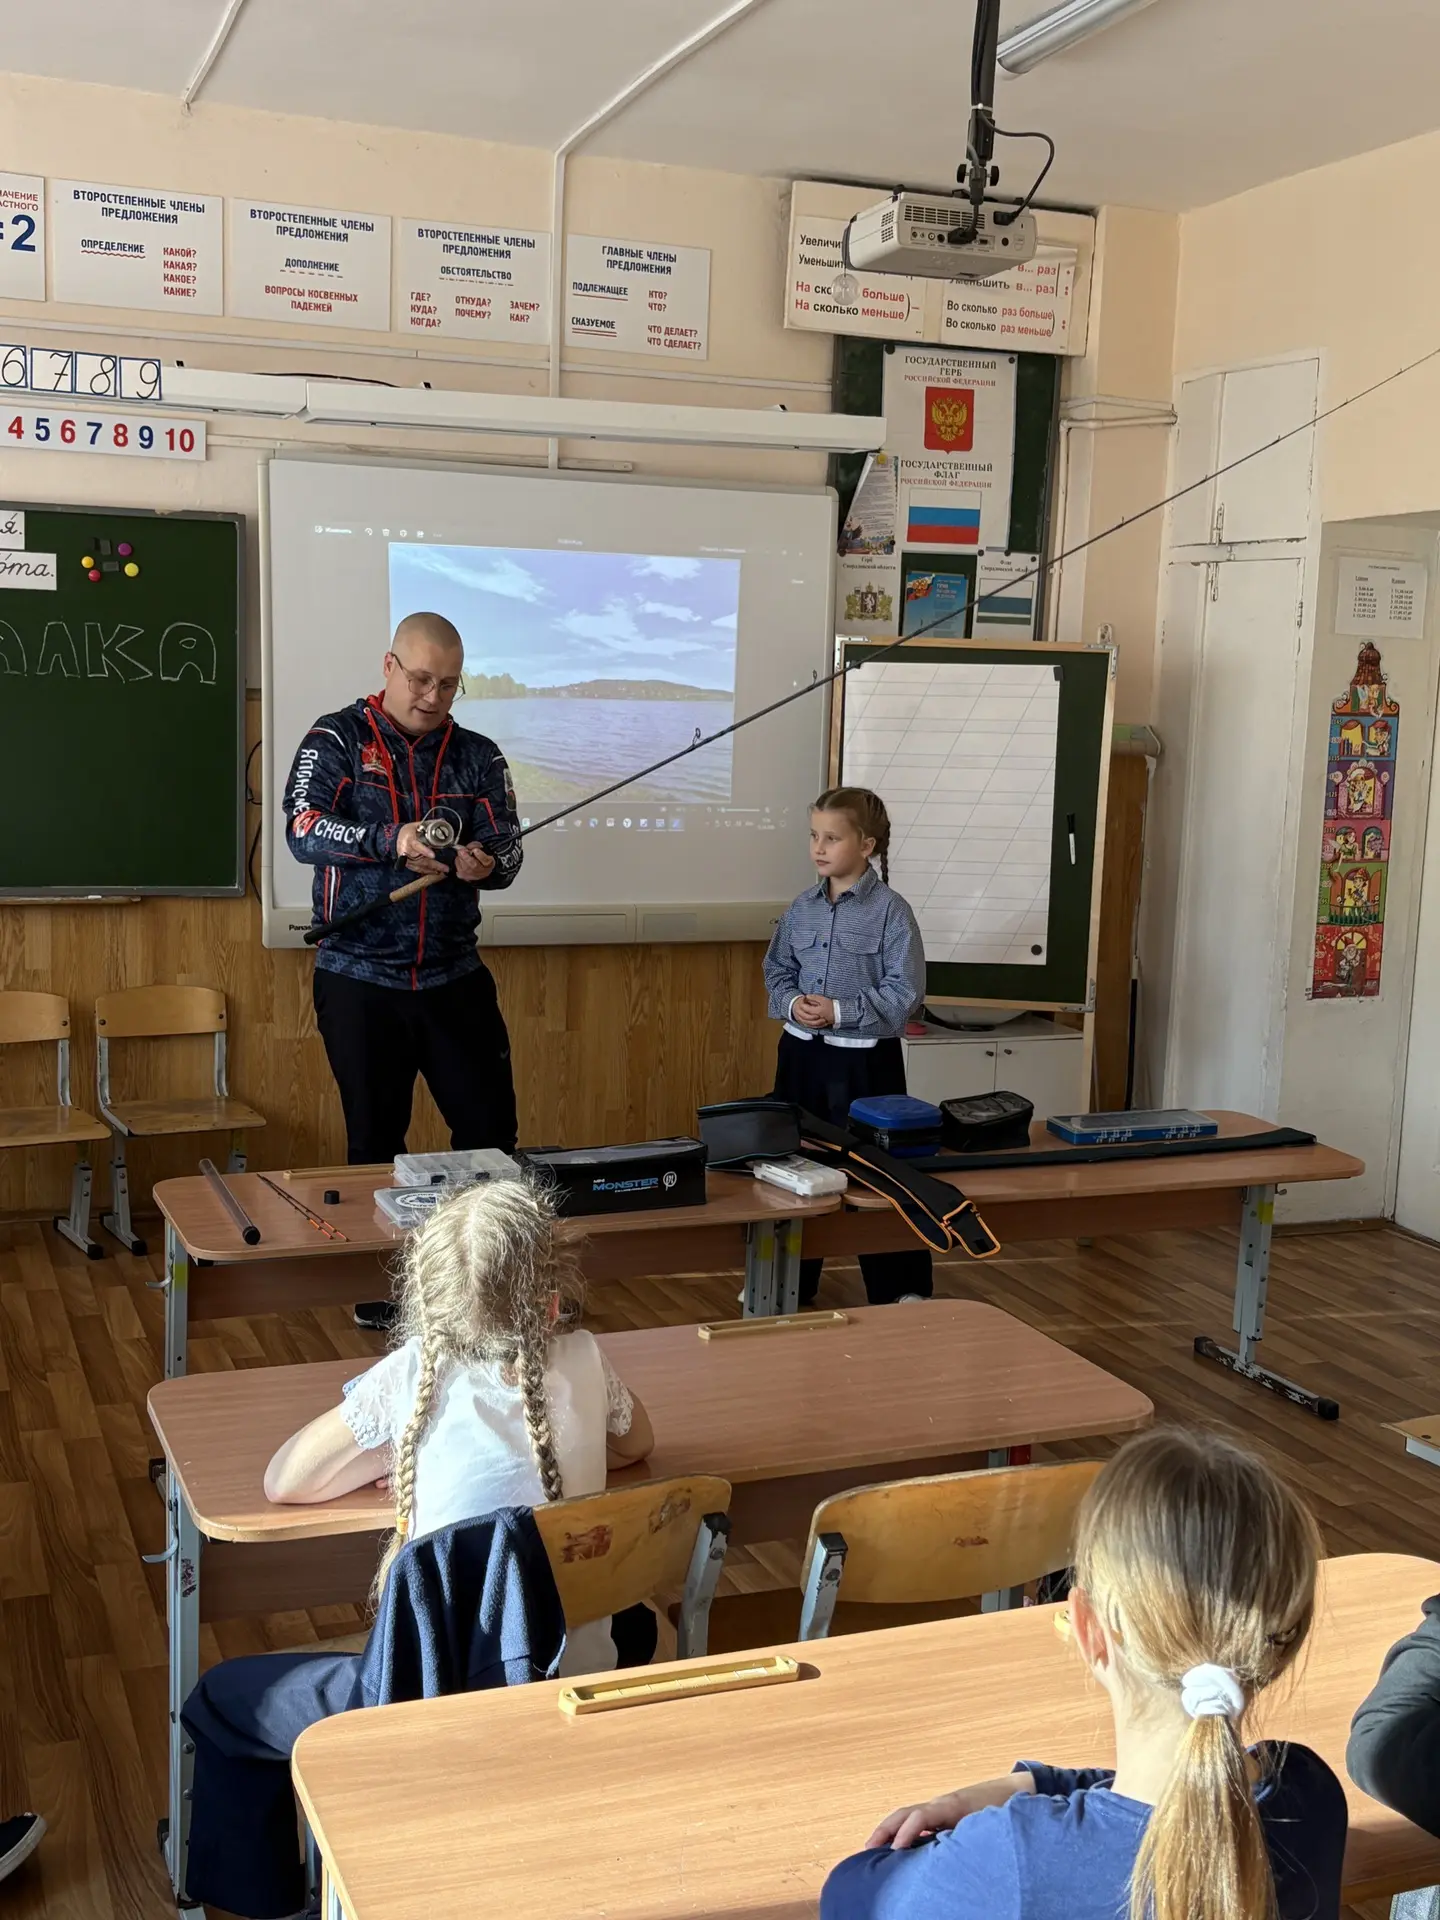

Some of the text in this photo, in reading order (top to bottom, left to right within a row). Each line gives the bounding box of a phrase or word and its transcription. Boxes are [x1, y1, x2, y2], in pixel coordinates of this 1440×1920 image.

[73, 189, 205, 214] ВТОРОСТЕПЕННЫЕ ЧЛЕНЫ
[101, 207, 178, 225] ПРЕДЛОЖЕНИЯ
[250, 208, 374, 232] ВТОРОСТЕПЕННЫЕ ЧЛЕНЫ
[0, 214, 36, 252] 2
[276, 225, 349, 243] ПРЕДЛОЖЕНИЯ
[417, 228, 536, 249] ВТОРОСТЕПЕННЫЕ ЧЛЕНЫ
[81, 239, 145, 254] ОПРЕДЕЛЕНИЕ
[800, 234, 842, 249] Увеличи
[163, 247, 197, 258] КАКОЙ?
[442, 243, 512, 260] ПРЕДЛОЖЕНИЯ
[602, 245, 677, 263] ГЛАВНЫЕ ЧЛЕНЫ
[163, 260, 198, 272] КАКАЯ?
[284, 258, 340, 272] ДОПОЛНЕНИЕ
[606, 259, 672, 275] ПРЕДЛОЖЕНИЯ
[798, 254, 845, 269] Уменьшит
[440, 265, 512, 280] ОБСТОЯТЕЛЬСТВО
[1036, 265, 1057, 276] раз
[163, 273, 197, 285] КАКОЕ?
[163, 286, 197, 298] КАКИЕ?
[264, 285, 359, 302] ВОПРОСЫ КОСВЕННЫХ
[572, 281, 629, 296] ПОДЛЕЖАЩЕЕ
[796, 281, 811, 293] На
[1035, 284, 1055, 295] раз
[410, 291, 432, 302] ГДЕ?
[455, 295, 492, 308] ОТКУДА?
[648, 290, 668, 300] КТО?
[862, 288, 905, 302] больше
[290, 300, 333, 313] ПАДЕЖЕЙ
[410, 304, 438, 315] КУДА?
[509, 300, 541, 312] ЗАЧЕМ?
[648, 302, 667, 312] ЧТО?
[795, 299, 905, 320] На сколько меньше
[946, 300, 1053, 320] Во сколько раз больше
[455, 308, 492, 320] ПОЧЕМУ?
[509, 313, 530, 324] КАК?
[410, 317, 442, 328] КОГДА?
[571, 316, 616, 329] СКАЗУЕМОЕ
[946, 317, 1053, 338] Во сколько раз меньше
[647, 325, 698, 338] ЧТО ДЕЛАЕТ?
[647, 337, 702, 351] ЧТО СДЕЛАЕТ?
[905, 356, 997, 370] ГОСУДАРСТВЕННЫЙ
[2, 347, 160, 399] 6 7 8 9
[940, 367, 962, 377] ГЕРБ
[904, 374, 996, 387] РОССИЙСКОЙ ФЕДЕРАЦИИ
[8, 416, 195, 453] 4 5 6 7 8 9 10
[900, 460, 993, 472] ГОСУДАРСТВЕННЫЙ
[934, 470, 960, 480] ФЛАГ
[592, 1177, 659, 1191] MONSTER
